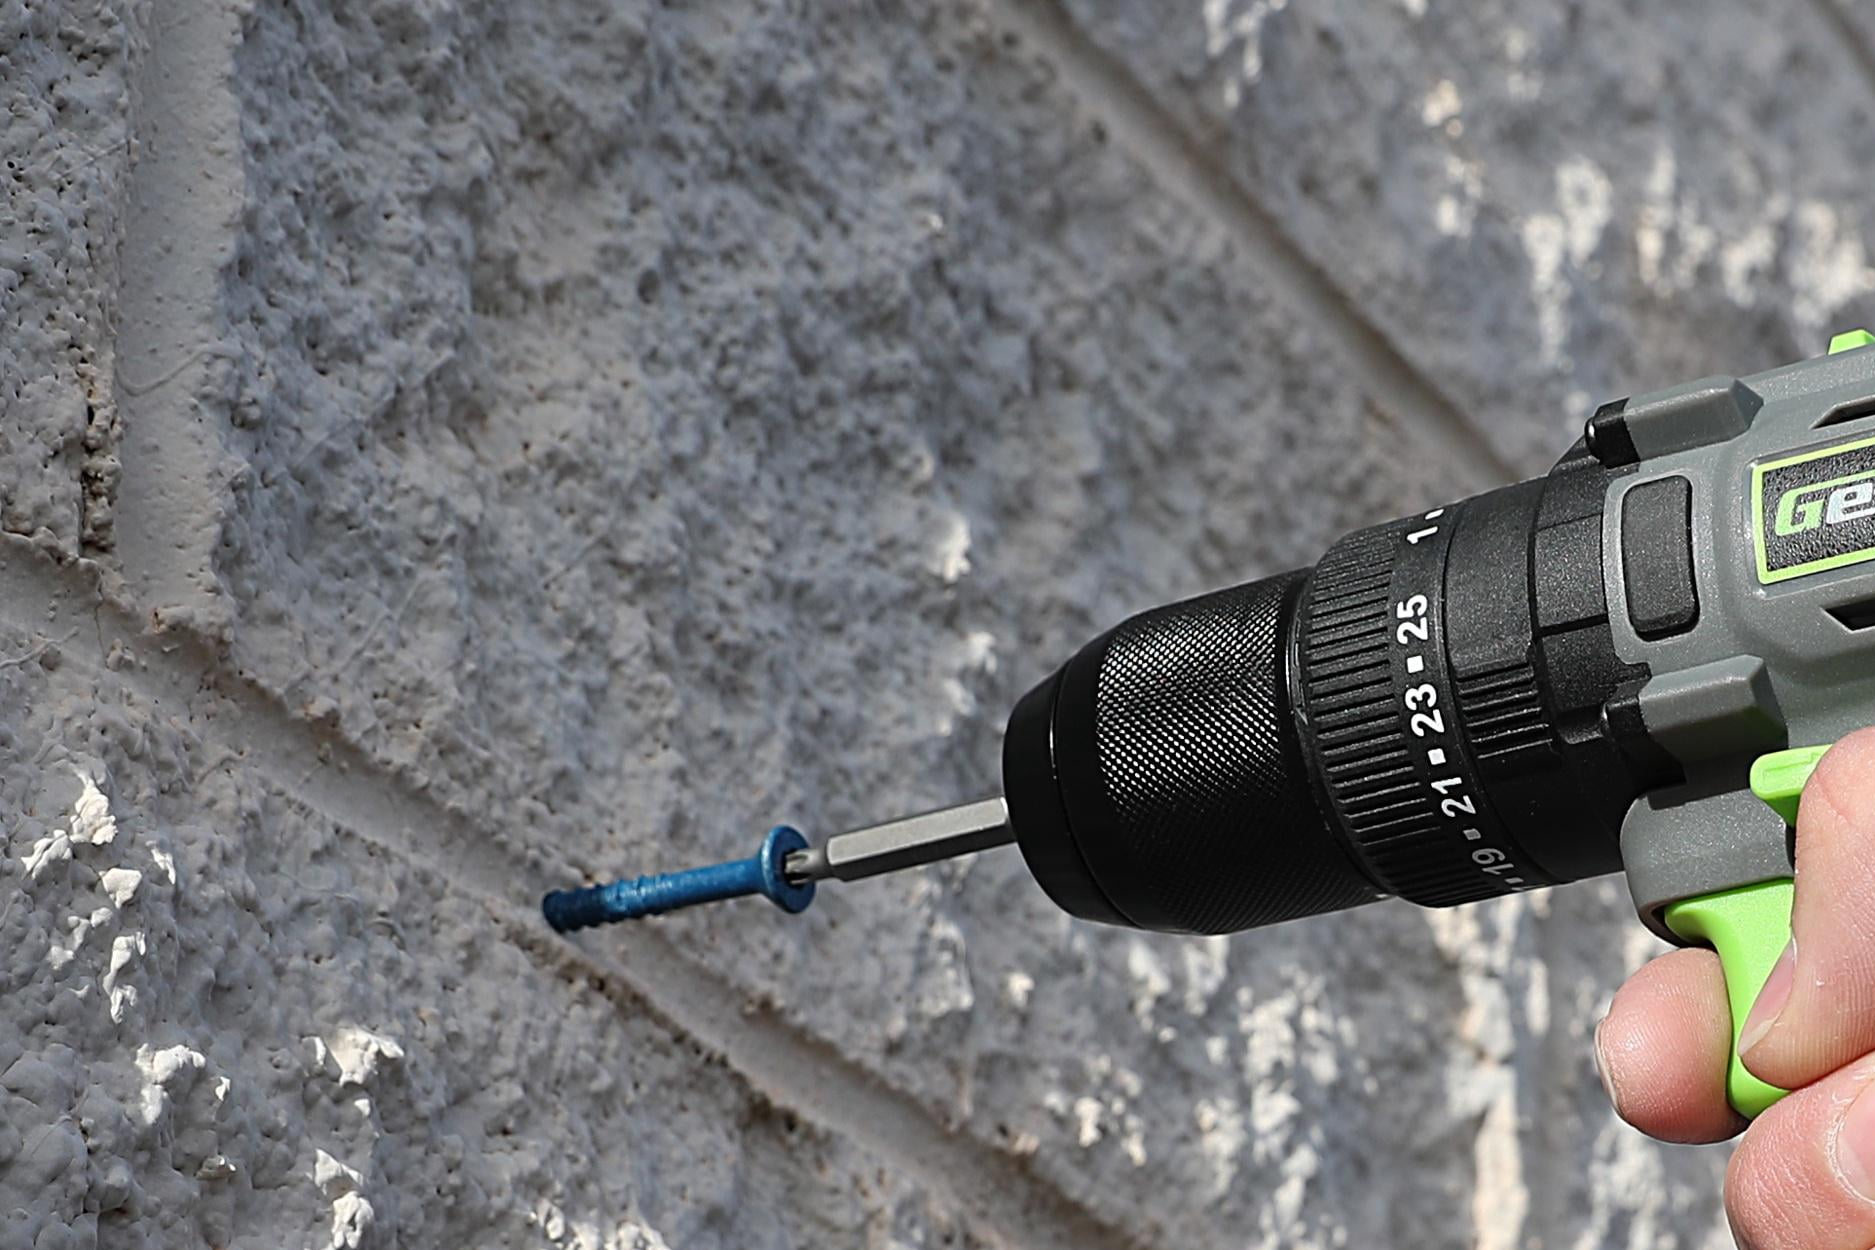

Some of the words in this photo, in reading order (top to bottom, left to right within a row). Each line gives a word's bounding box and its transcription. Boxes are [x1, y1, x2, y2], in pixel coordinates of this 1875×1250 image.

[1397, 595, 1428, 645] 25
[1405, 683, 1445, 737] 23
[1431, 777, 1476, 818] 21
[1472, 847, 1514, 875] 19
